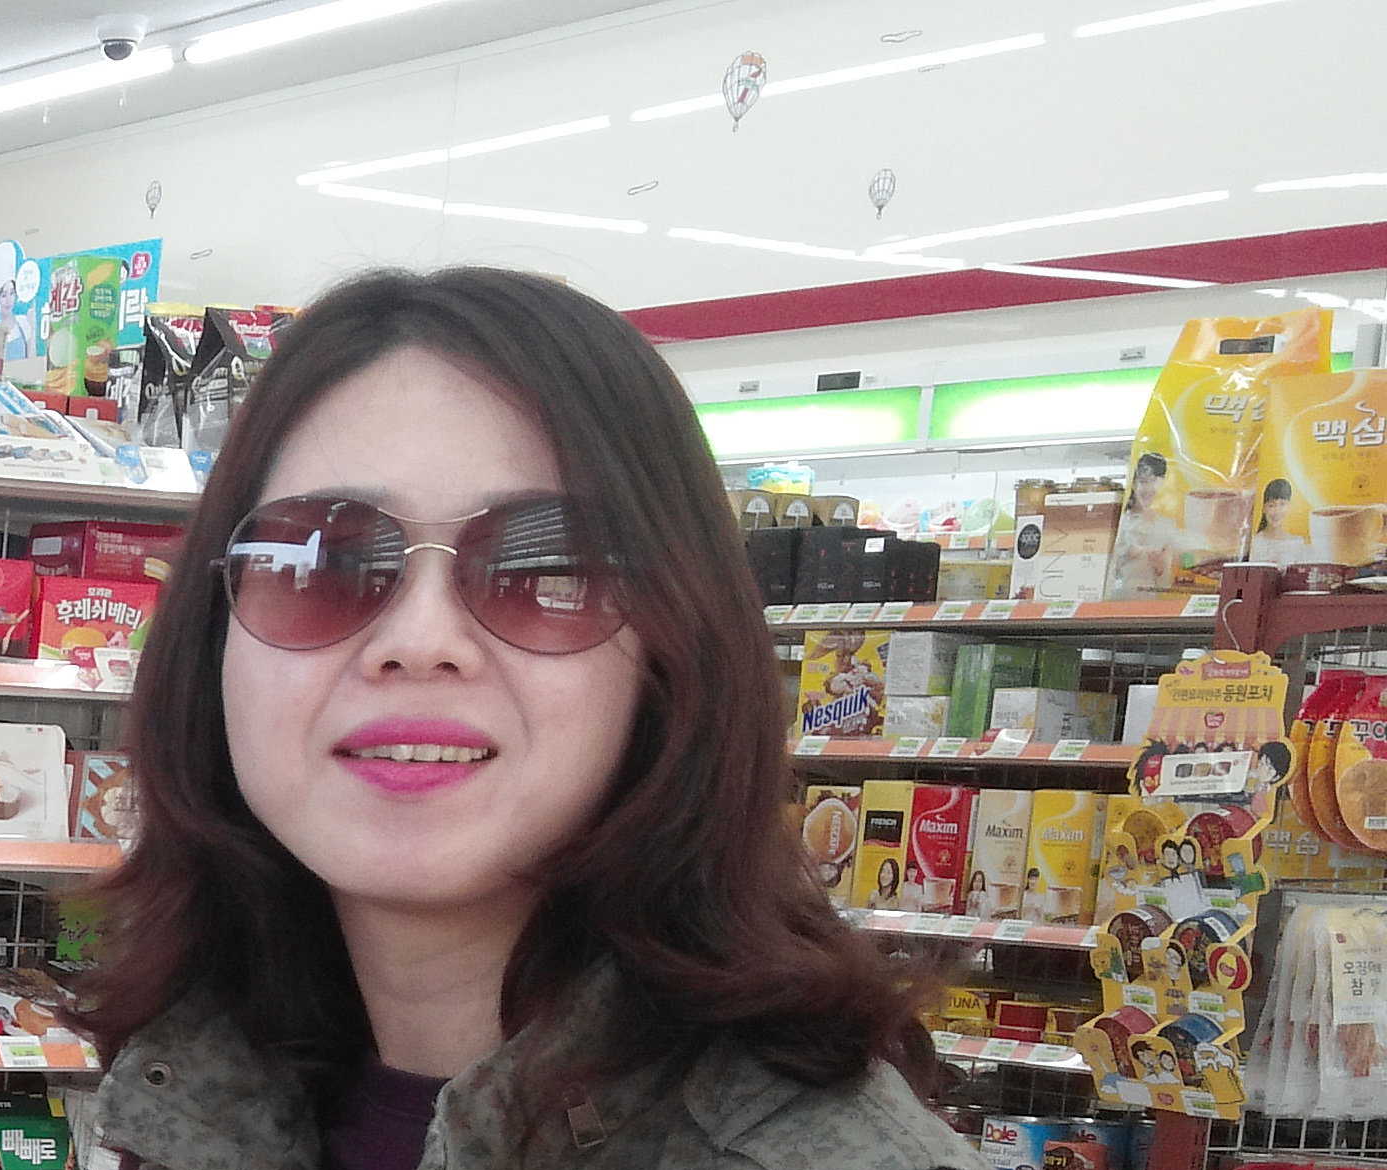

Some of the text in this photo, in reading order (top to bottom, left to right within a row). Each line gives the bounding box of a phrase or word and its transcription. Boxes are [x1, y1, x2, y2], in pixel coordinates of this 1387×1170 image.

[1313, 405, 1387, 449] 맥심
[56, 597, 142, 629] 후레쉬베리
[801, 687, 871, 734] Nesquik
[918, 816, 958, 835] Maxim
[984, 821, 1024, 841] Maxim
[1041, 821, 1084, 841] Maxim
[984, 1121, 1018, 1143] Dole
[1, 1128, 57, 1165] 빼빼로
